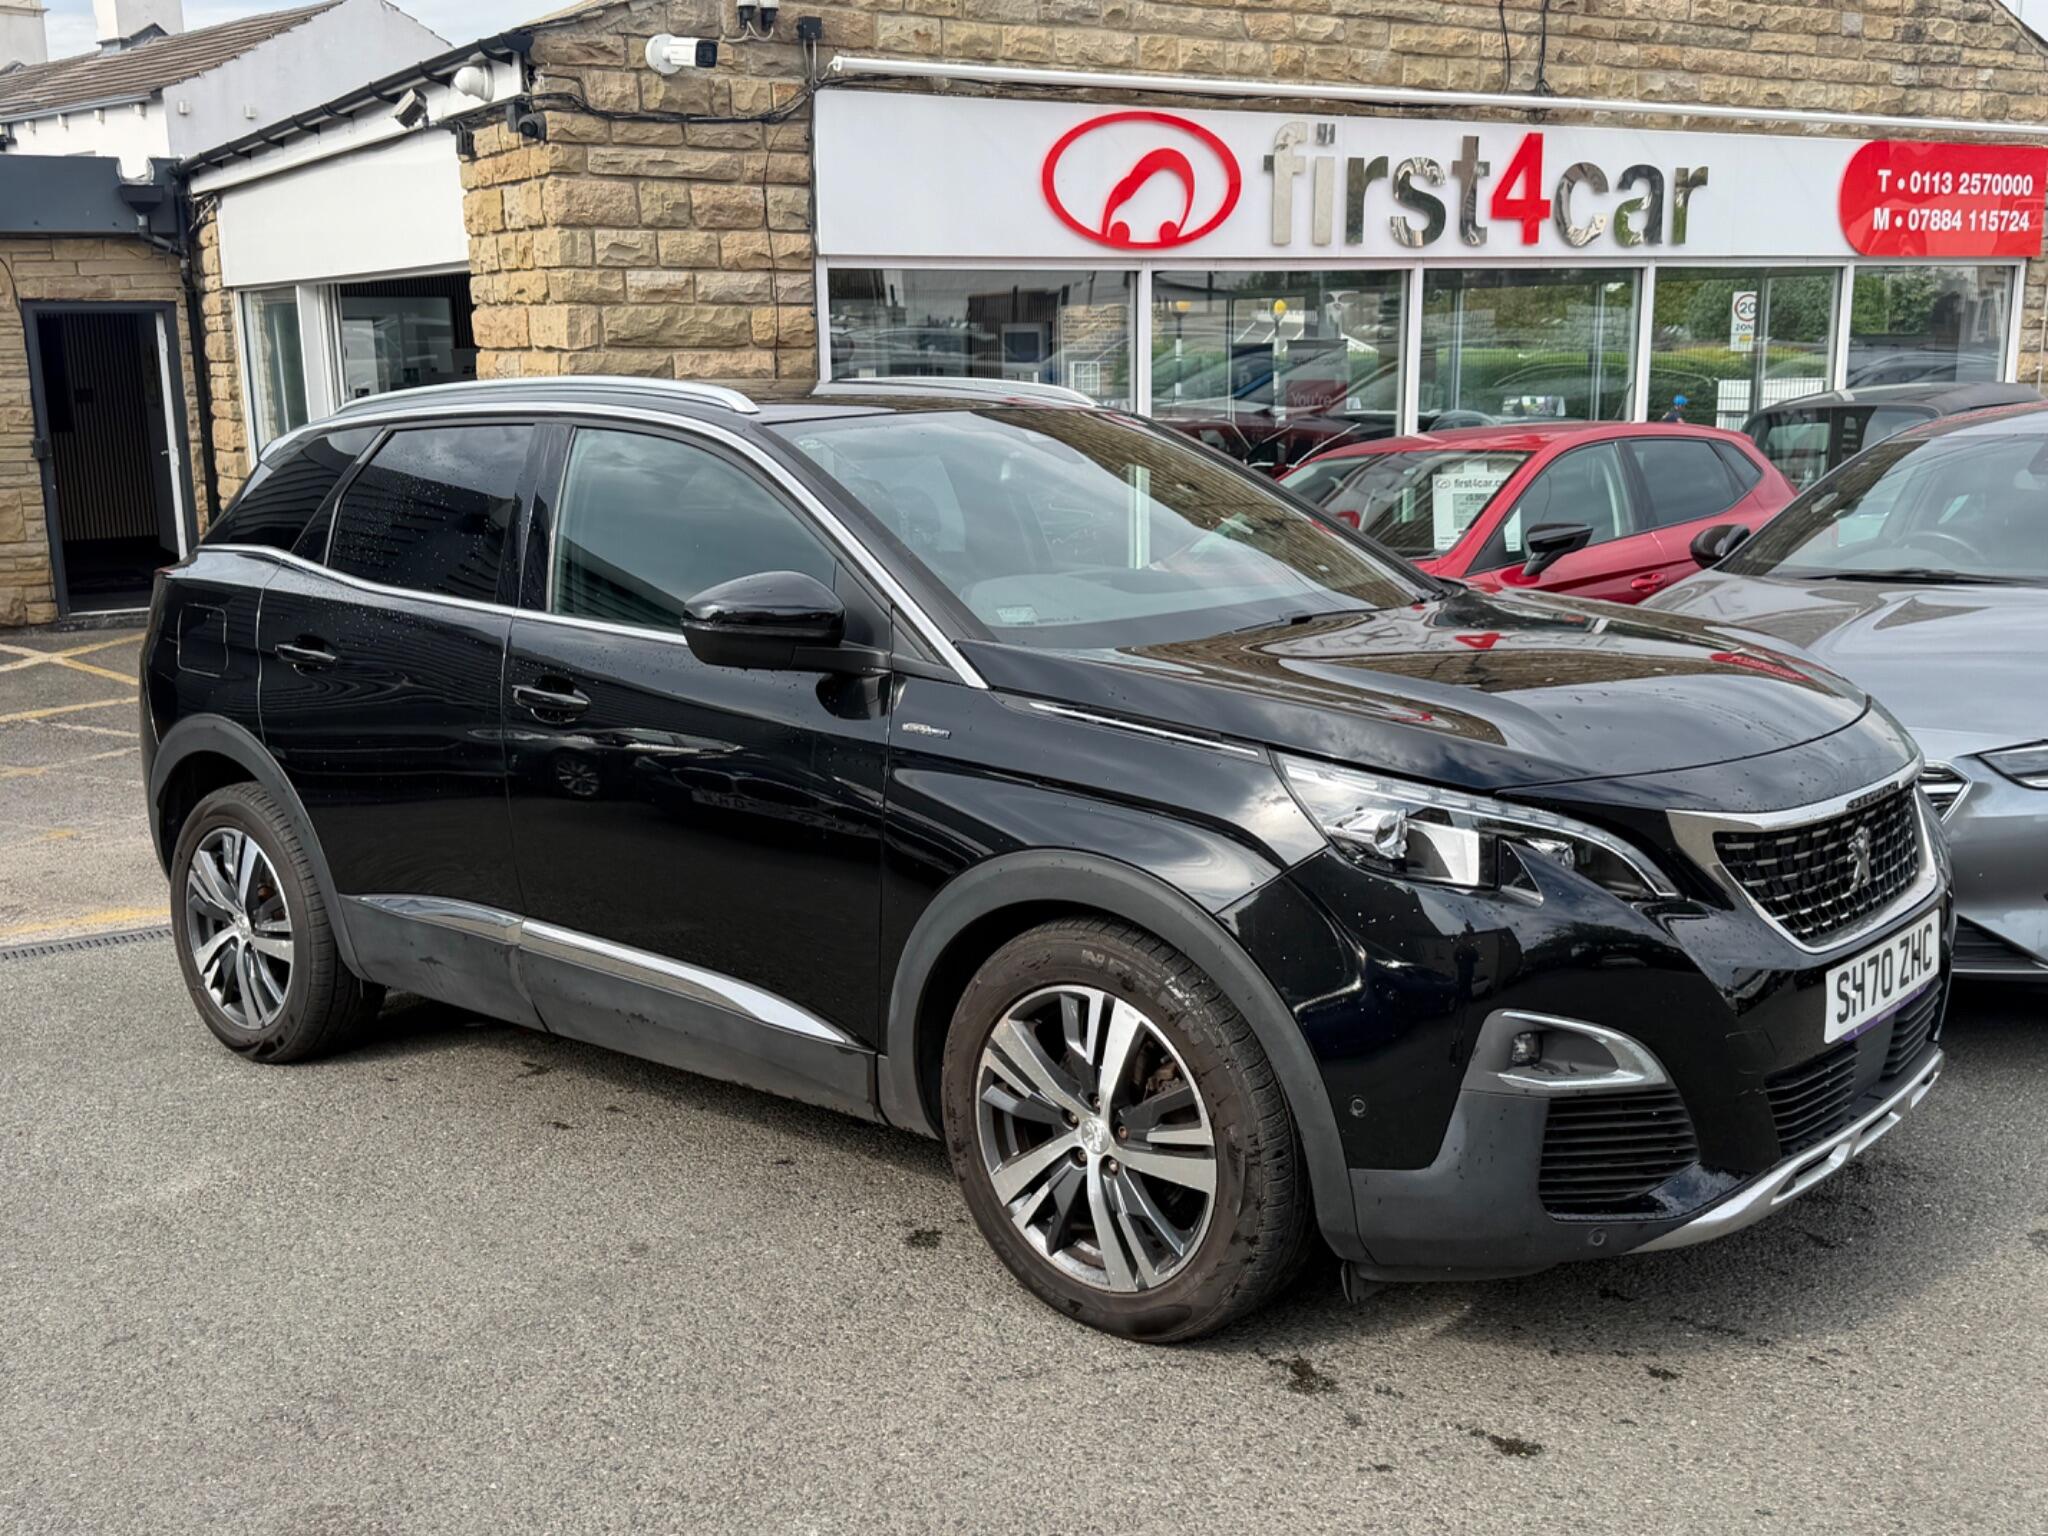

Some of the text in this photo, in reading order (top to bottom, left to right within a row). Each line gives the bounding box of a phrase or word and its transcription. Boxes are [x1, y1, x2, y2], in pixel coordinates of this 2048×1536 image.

[1263, 121, 1709, 247] first4car
[1910, 171, 1953, 194] 0113
[1958, 173, 2033, 196] 2570000
[1908, 208, 1962, 232] 07884
[1969, 210, 2030, 232] 115724
[1836, 922, 1933, 1024] SH70 ZHC
